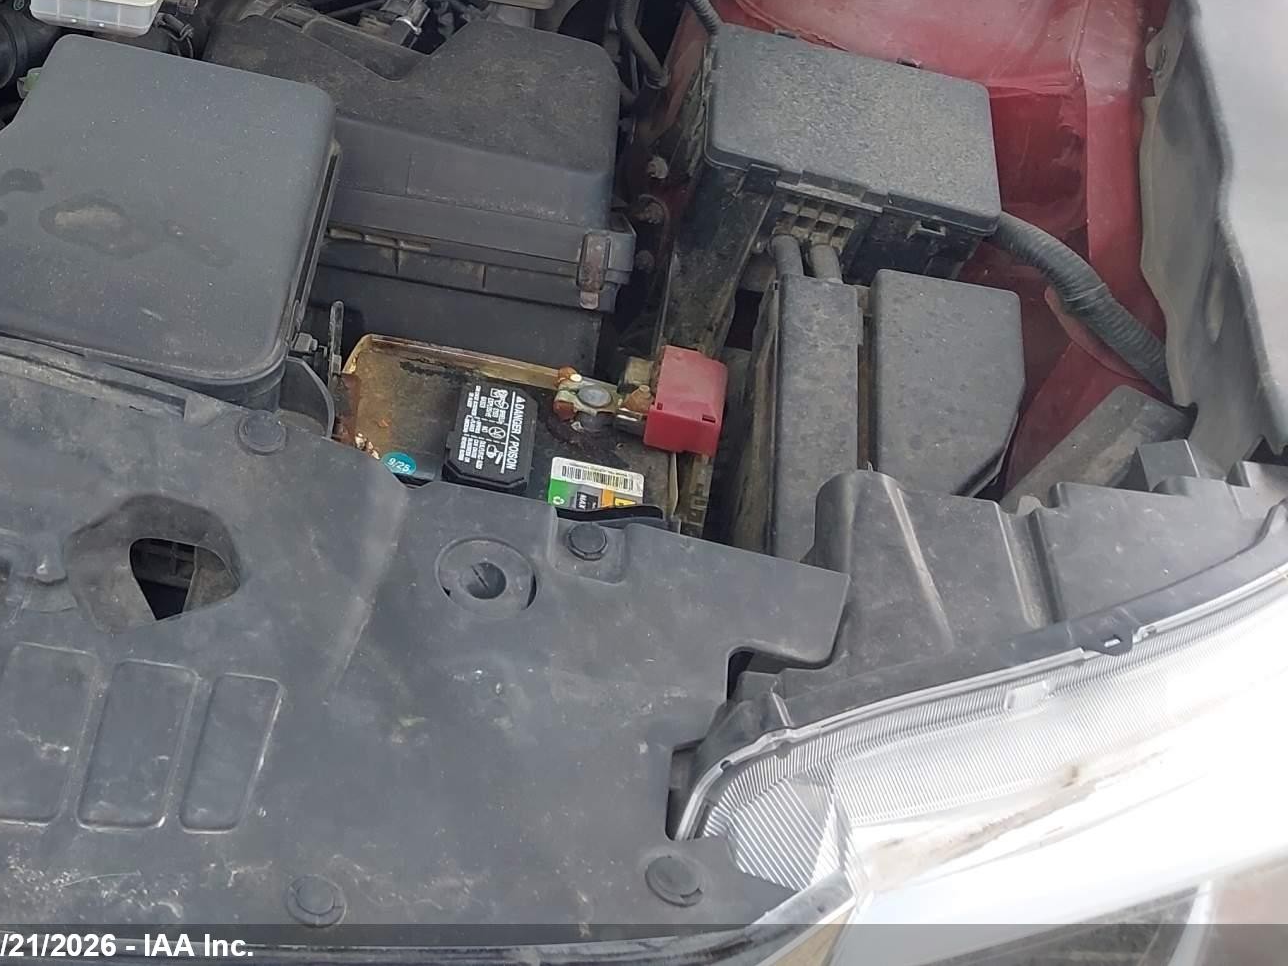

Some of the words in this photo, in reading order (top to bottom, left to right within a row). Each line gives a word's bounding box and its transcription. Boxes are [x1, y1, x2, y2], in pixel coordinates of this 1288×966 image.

[510, 403, 525, 434] DANGER
[387, 457, 411, 472] 9/25
[505, 440, 520, 471] POISON
